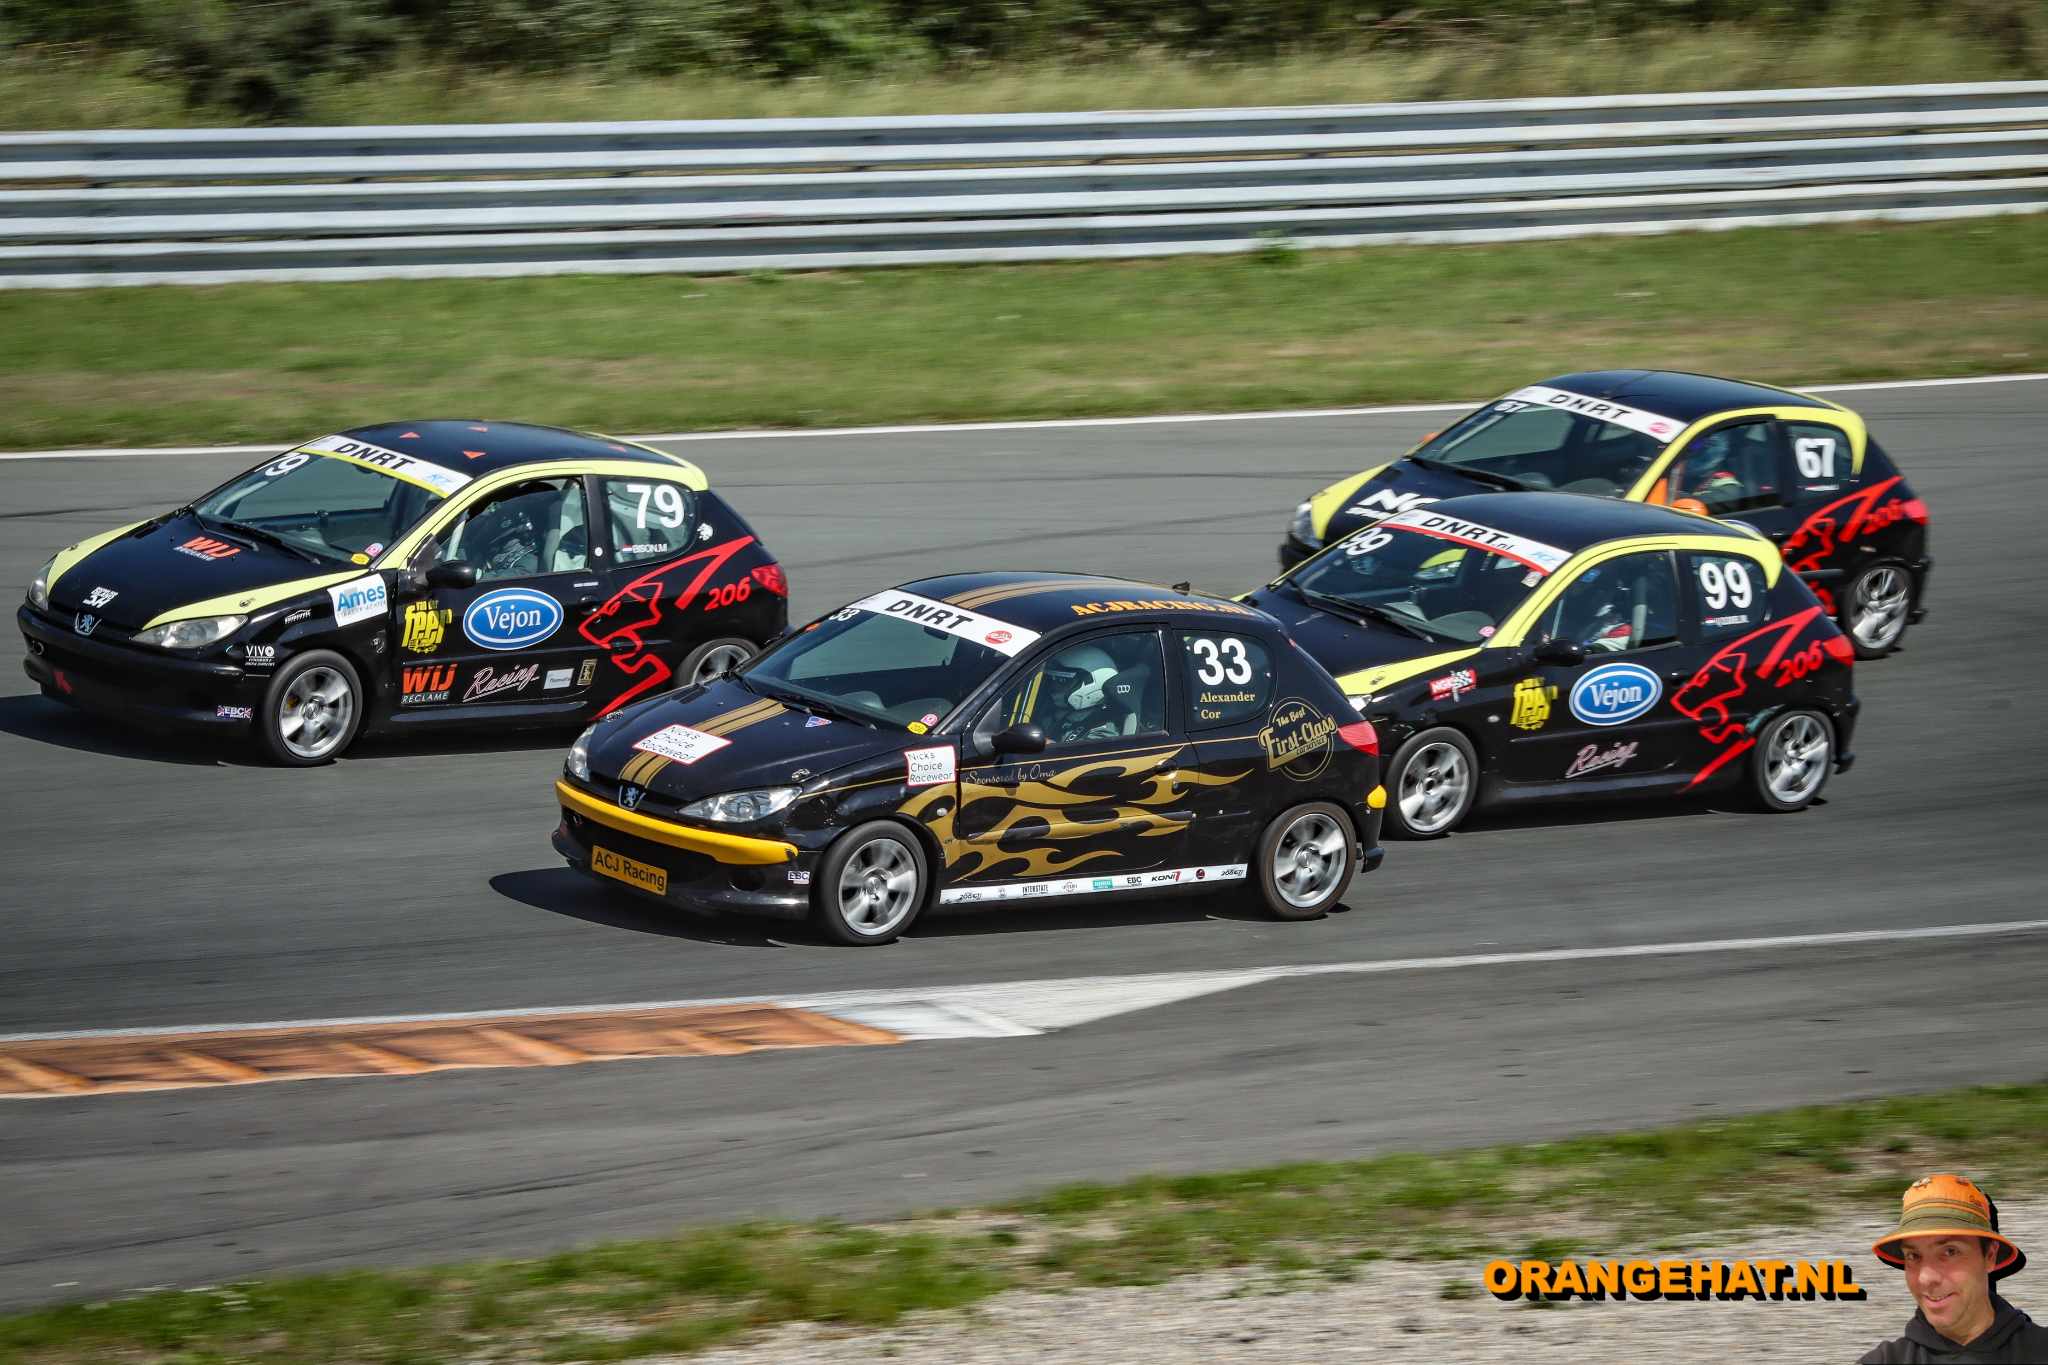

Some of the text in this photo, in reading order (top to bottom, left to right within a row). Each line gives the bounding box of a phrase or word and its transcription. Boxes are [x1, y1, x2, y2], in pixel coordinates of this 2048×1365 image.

[1549, 394, 1632, 419] DNRT
[333, 443, 416, 470] DNRT
[1795, 438, 1836, 478] 67
[626, 484, 685, 529] 79
[337, 585, 385, 612] Ames
[704, 576, 751, 611] 206
[1699, 561, 1753, 610] 99
[484, 605, 542, 637] Vejon
[885, 599, 974, 630] DNRT
[246, 645, 275, 657] VIVO
[1193, 638, 1253, 686] 33
[1775, 640, 1823, 688] 206
[403, 663, 459, 694] WIJ
[462, 664, 540, 702] Racing
[401, 692, 449, 704] RECLAME
[1200, 691, 1256, 703] Alexander
[1589, 682, 1643, 711] Vejon
[1200, 709, 1221, 720] Cor
[1259, 716, 1336, 768] First-Class
[910, 763, 943, 773] Choice
[910, 772, 952, 784] Racewear
[1017, 767, 1028, 781] by
[594, 852, 665, 891] ACJ Racing
[788, 871, 809, 881] EBC
